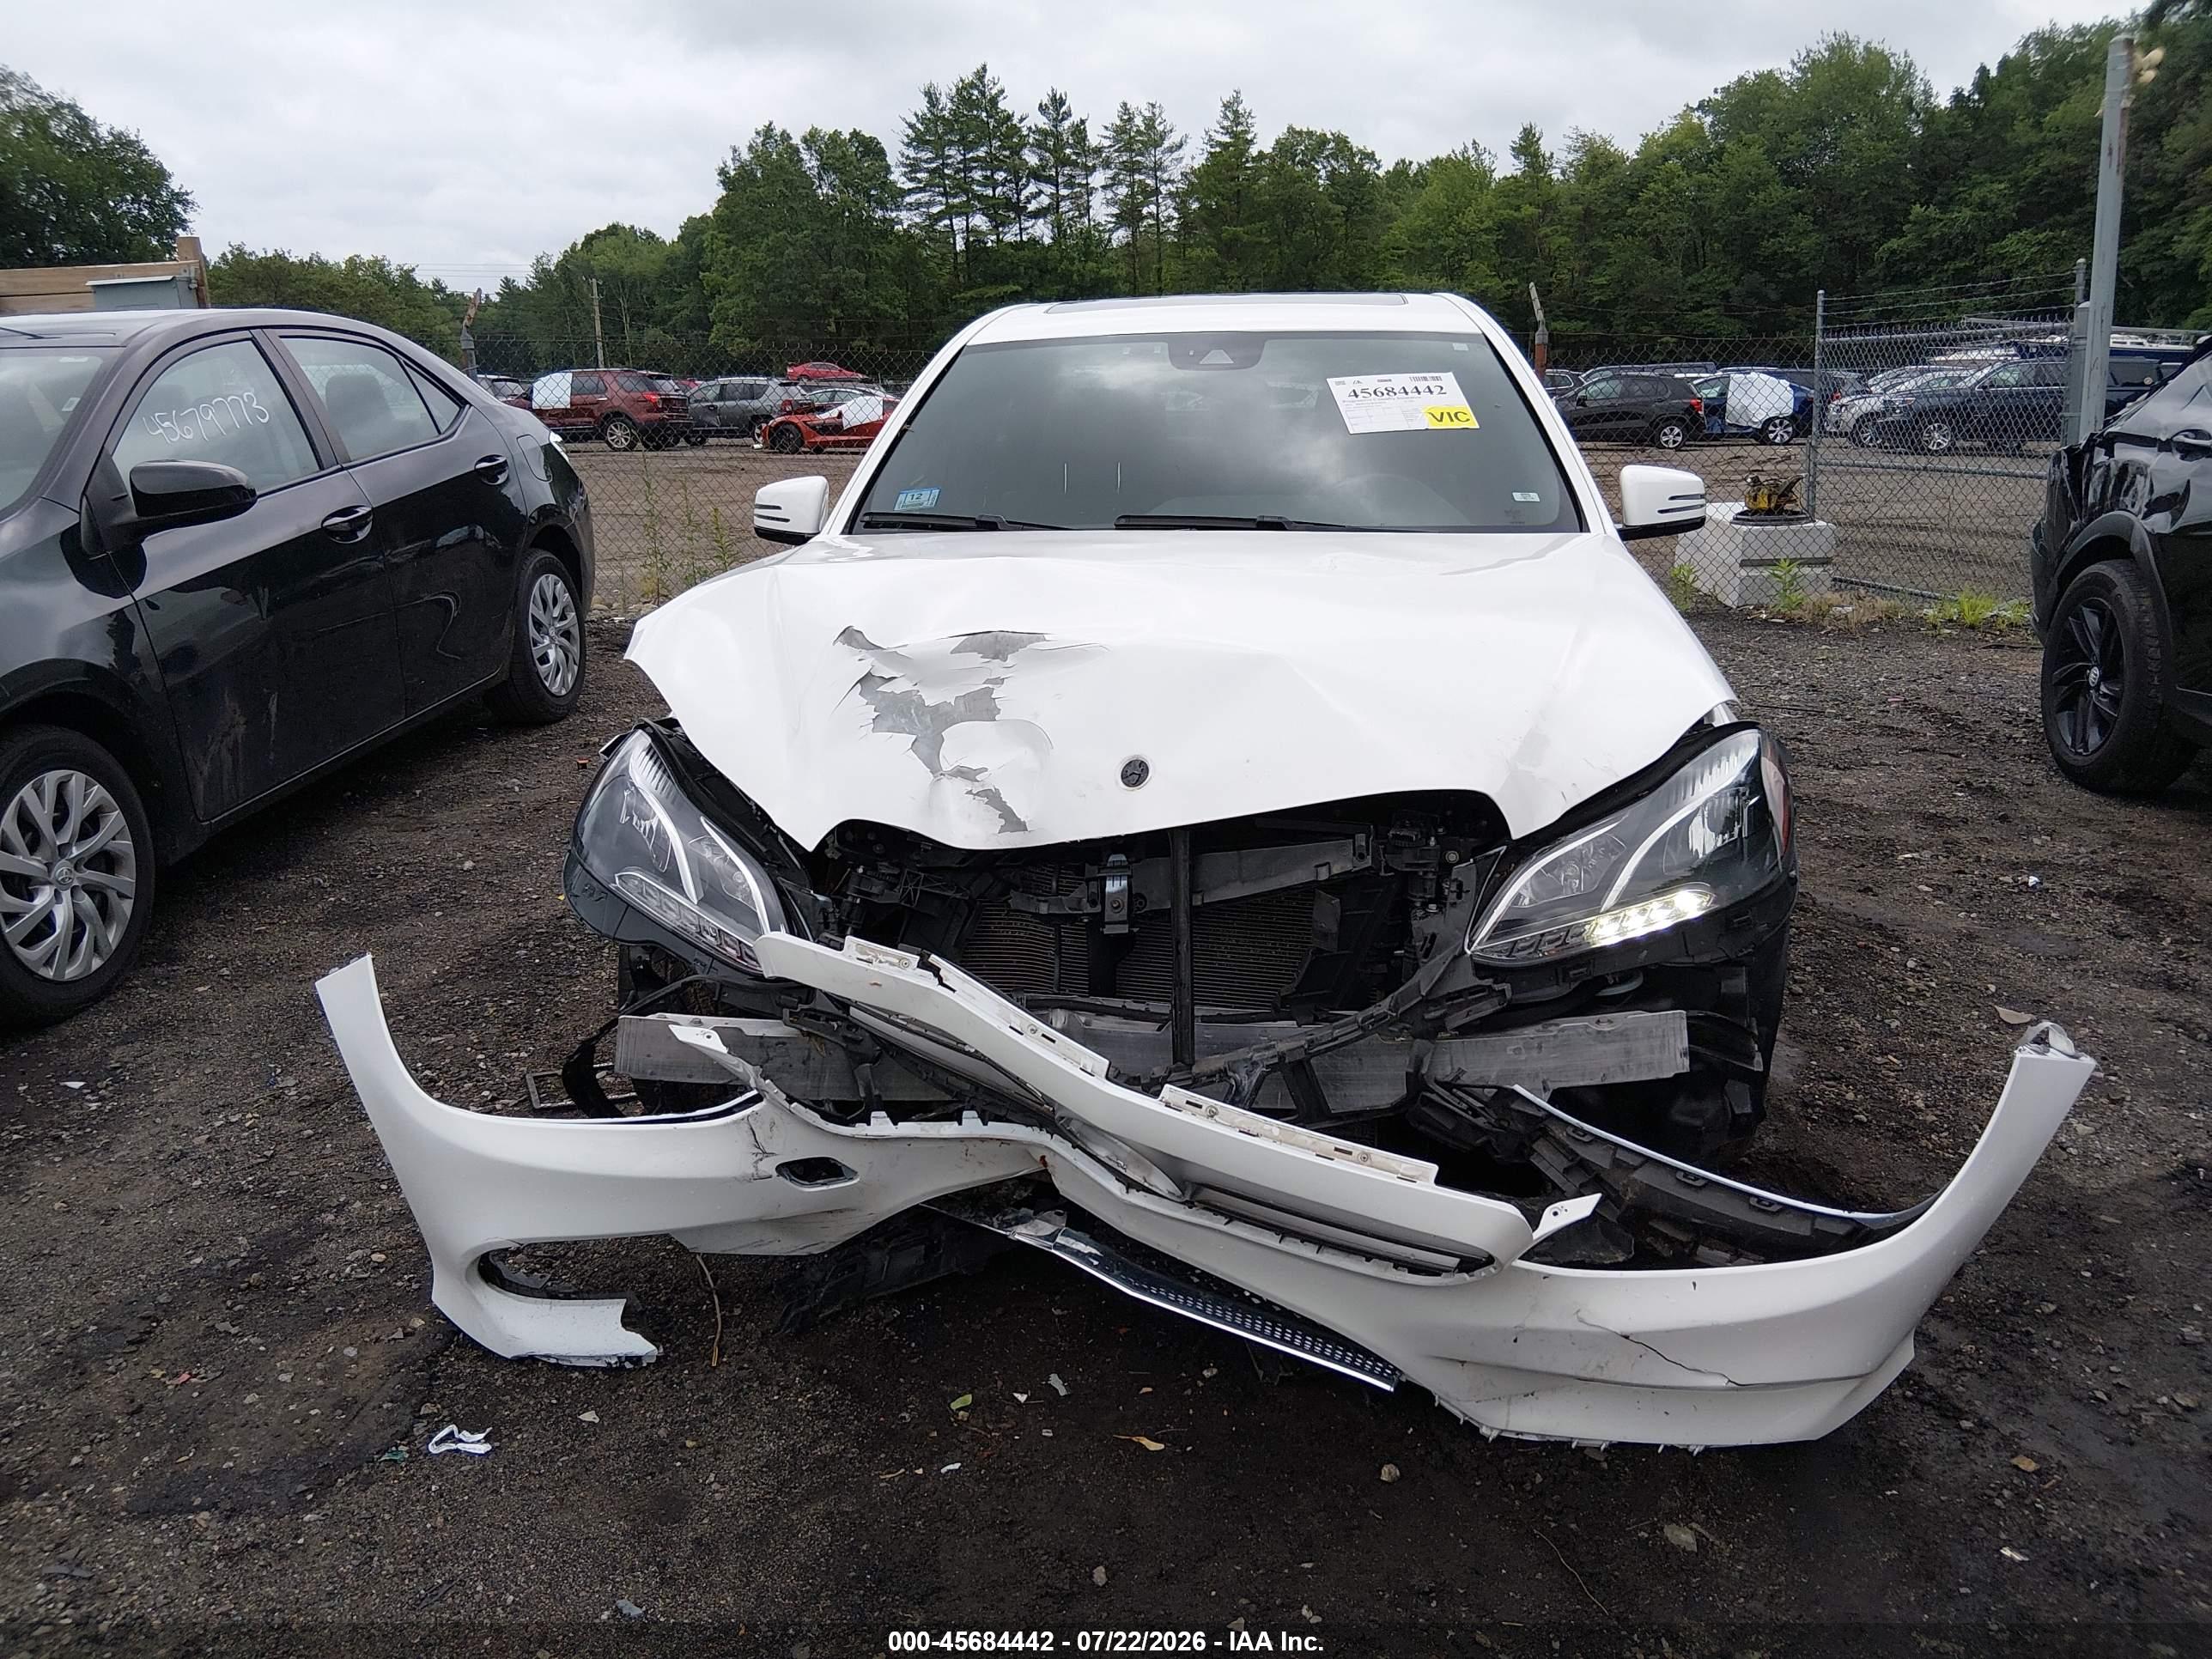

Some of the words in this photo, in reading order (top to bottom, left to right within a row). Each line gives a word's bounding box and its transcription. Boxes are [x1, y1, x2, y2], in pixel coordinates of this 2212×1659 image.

[1347, 385, 1447, 399] 45684442
[143, 392, 268, 443] 45679773
[1429, 410, 1470, 422] VIC
